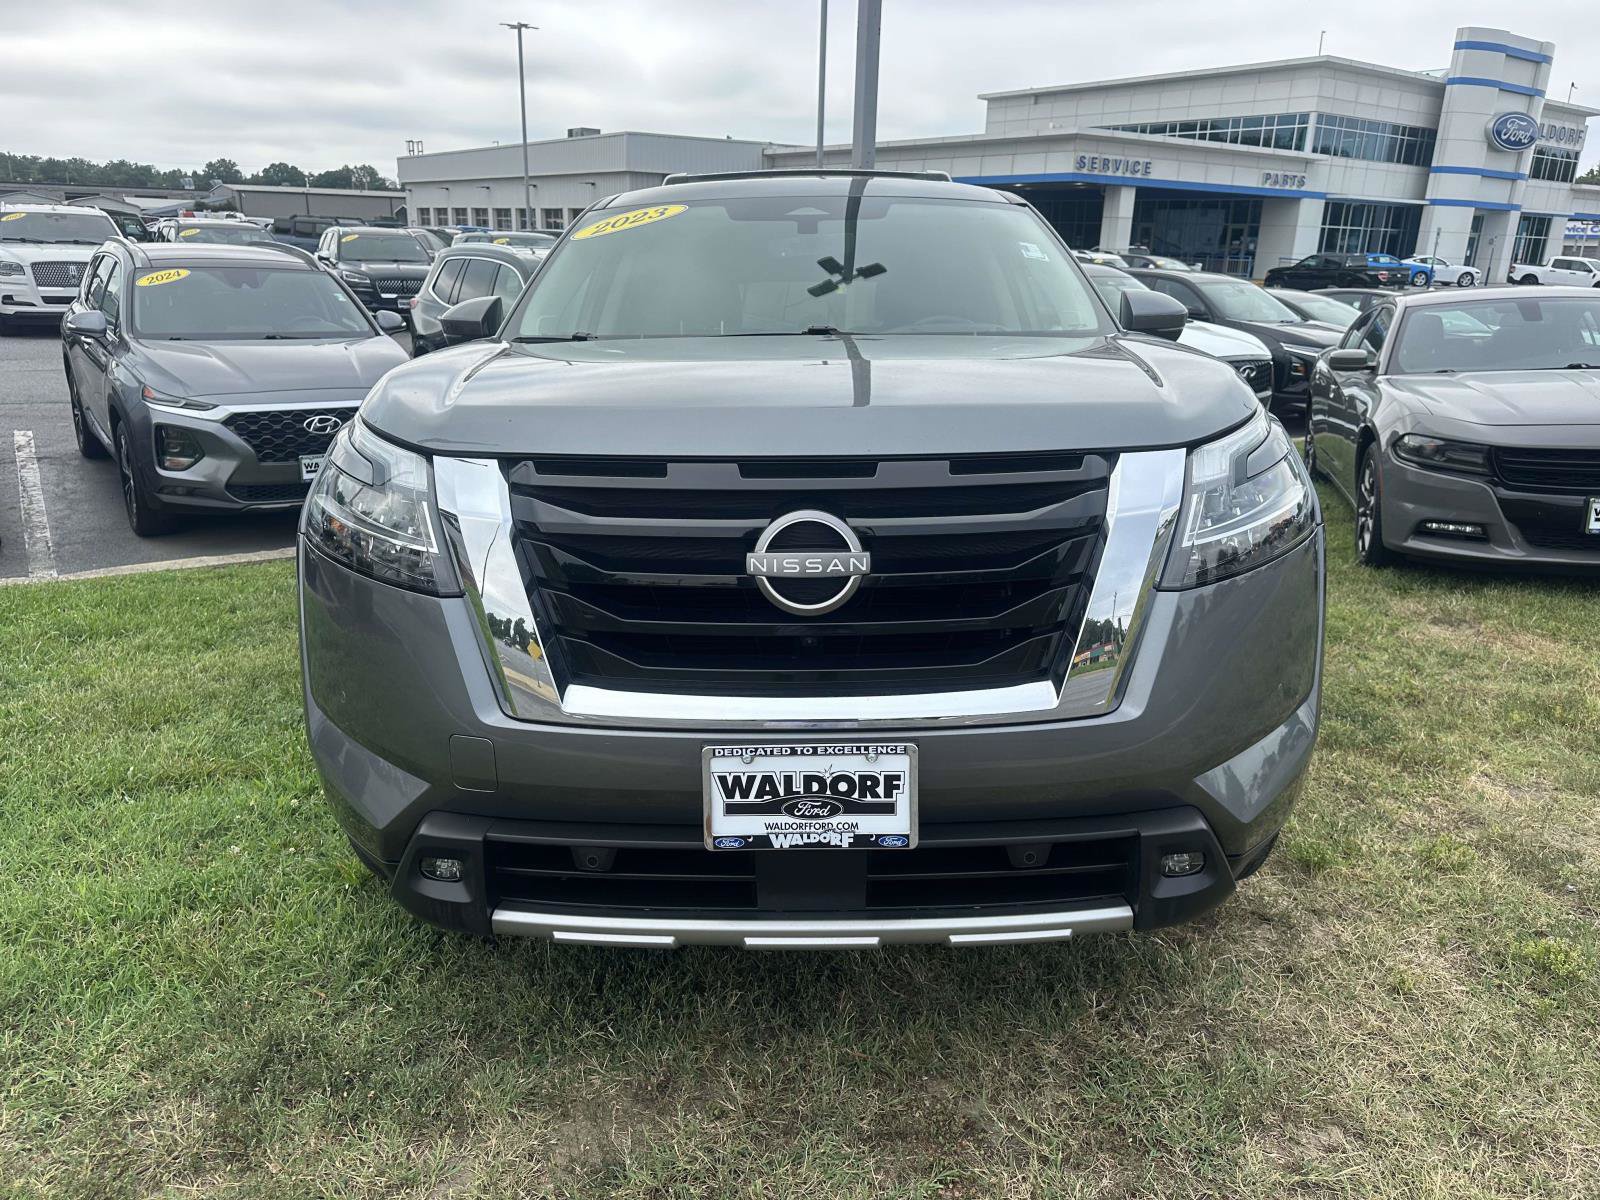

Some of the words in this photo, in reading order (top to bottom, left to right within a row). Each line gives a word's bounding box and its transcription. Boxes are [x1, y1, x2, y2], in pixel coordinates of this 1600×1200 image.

[1501, 118, 1532, 143] Ford
[1540, 123, 1584, 145] LDORF
[1076, 154, 1152, 176] SERVICE
[1263, 172, 1306, 188] PARTS
[590, 207, 669, 235] 2023
[146, 270, 181, 285] 2024
[750, 557, 867, 573] NISSAN
[714, 746, 791, 756] DEDICATED
[795, 746, 813, 755] TO
[817, 745, 907, 755] EXCELLENCE
[715, 772, 902, 800] WALDORF
[793, 800, 831, 817] Ford
[764, 821, 859, 831] WALDORFFORD.COM
[719, 838, 741, 847] Ford
[768, 832, 854, 849] WALDORF
[882, 837, 904, 846] Ford
